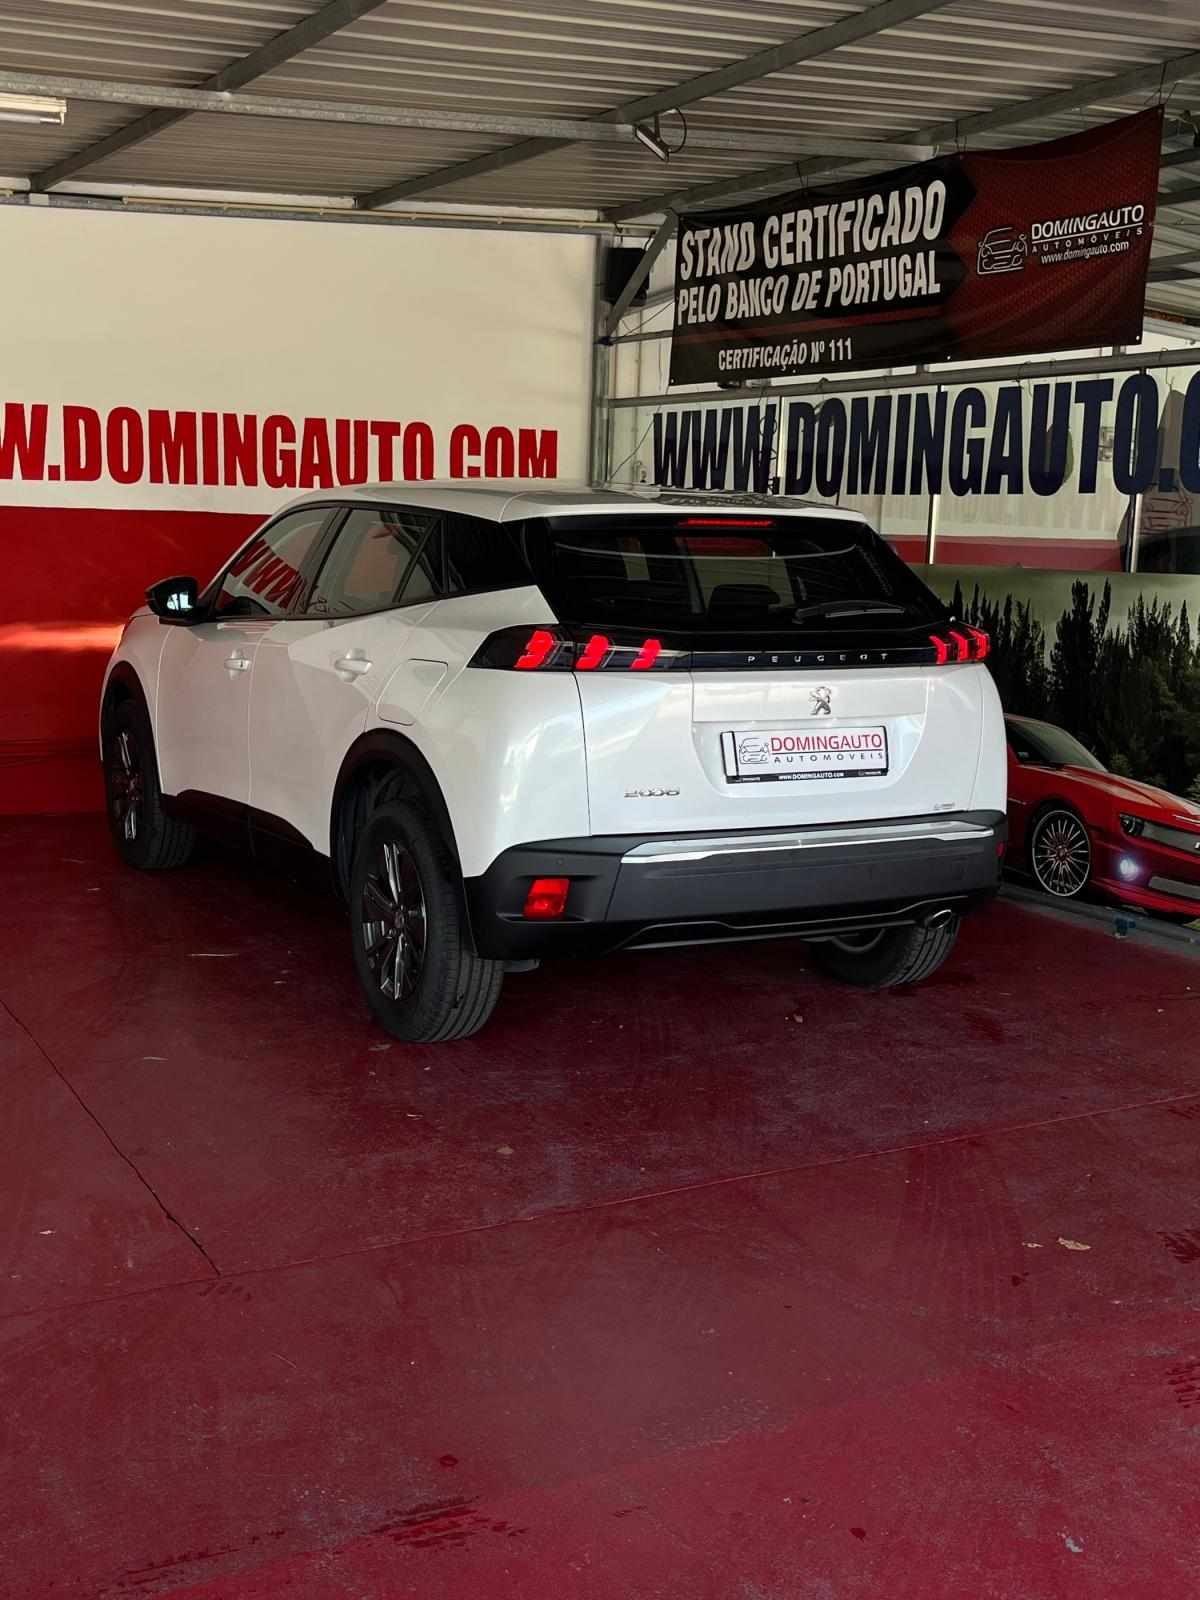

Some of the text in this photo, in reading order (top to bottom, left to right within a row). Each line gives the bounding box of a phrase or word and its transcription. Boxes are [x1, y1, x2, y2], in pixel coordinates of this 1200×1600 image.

[680, 179, 947, 280] STAND CERTIFICADO
[1031, 204, 1145, 240] DOMINGAUTO
[1040, 240, 1130, 265] www.domingauto.com
[677, 250, 941, 326] PELO BANCO DE PORTUGAL
[718, 339, 808, 371] CERTIFICAÇÃO
[829, 337, 852, 361] 111
[747, 652, 889, 664] PEUGEOT
[770, 734, 883, 752] DOMINGAUTO
